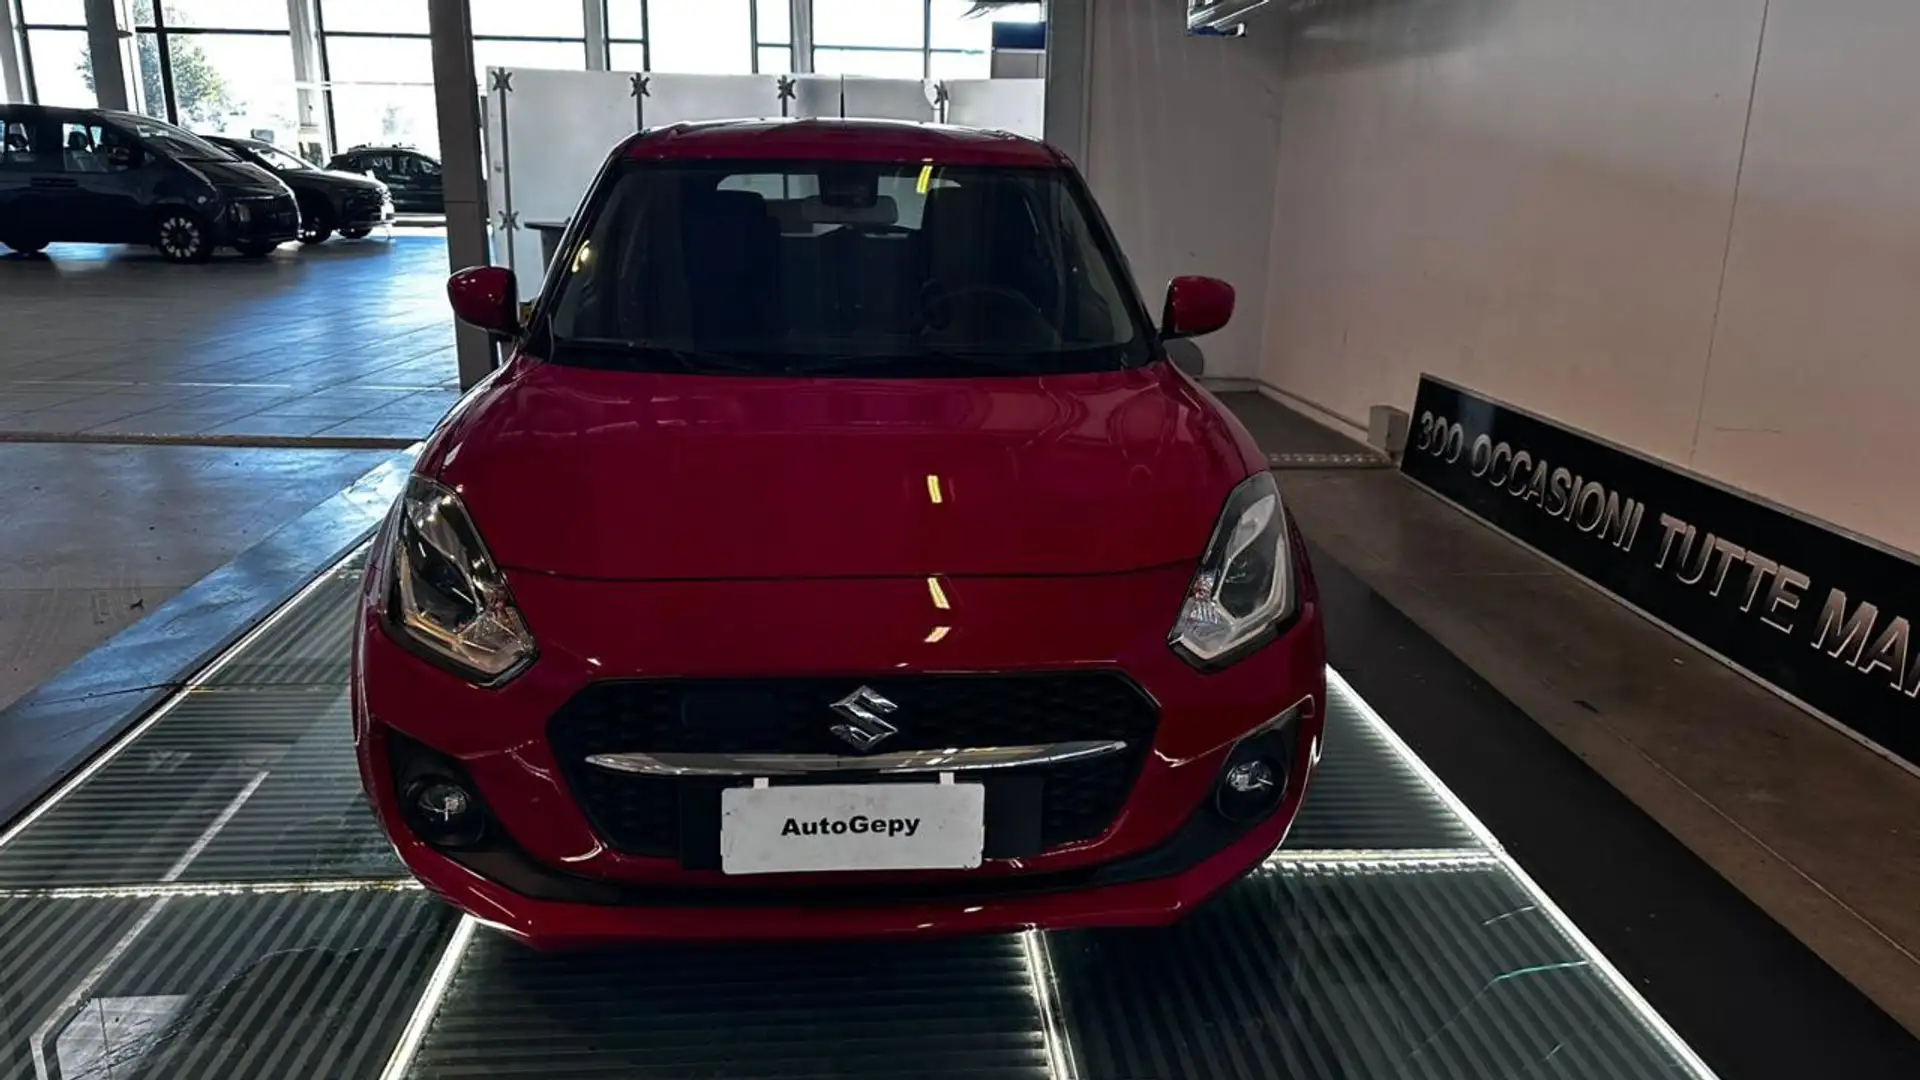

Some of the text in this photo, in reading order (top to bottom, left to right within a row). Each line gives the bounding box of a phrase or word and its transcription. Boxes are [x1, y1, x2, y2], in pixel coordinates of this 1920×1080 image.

[1417, 410, 1920, 698] 300 OCCASIONI TUTTE MA
[781, 815, 920, 836] AutoGepy
